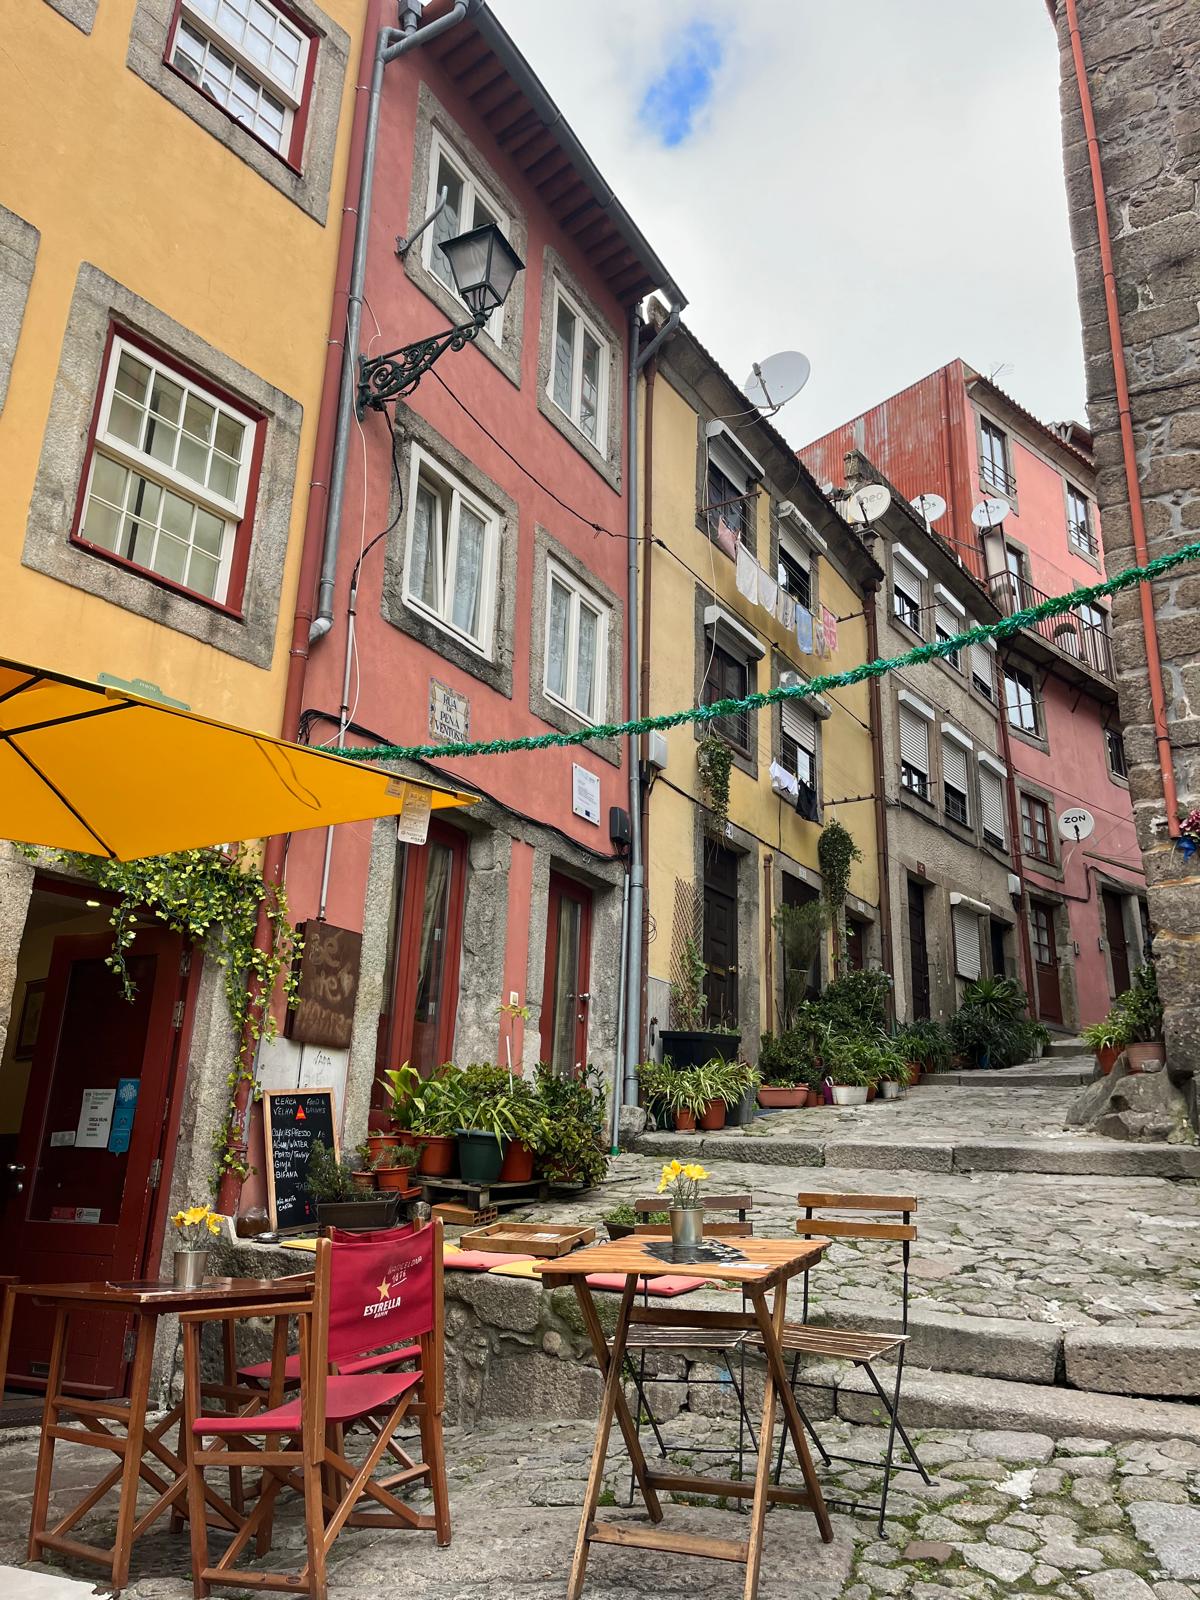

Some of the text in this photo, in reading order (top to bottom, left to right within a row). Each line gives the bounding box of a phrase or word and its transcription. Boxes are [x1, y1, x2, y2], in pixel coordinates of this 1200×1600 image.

[443, 694, 457, 710] RUA
[441, 711, 460, 730] PENA
[1064, 815, 1086, 824] ZON
[363, 1296, 401, 1317] ESTRELLA
